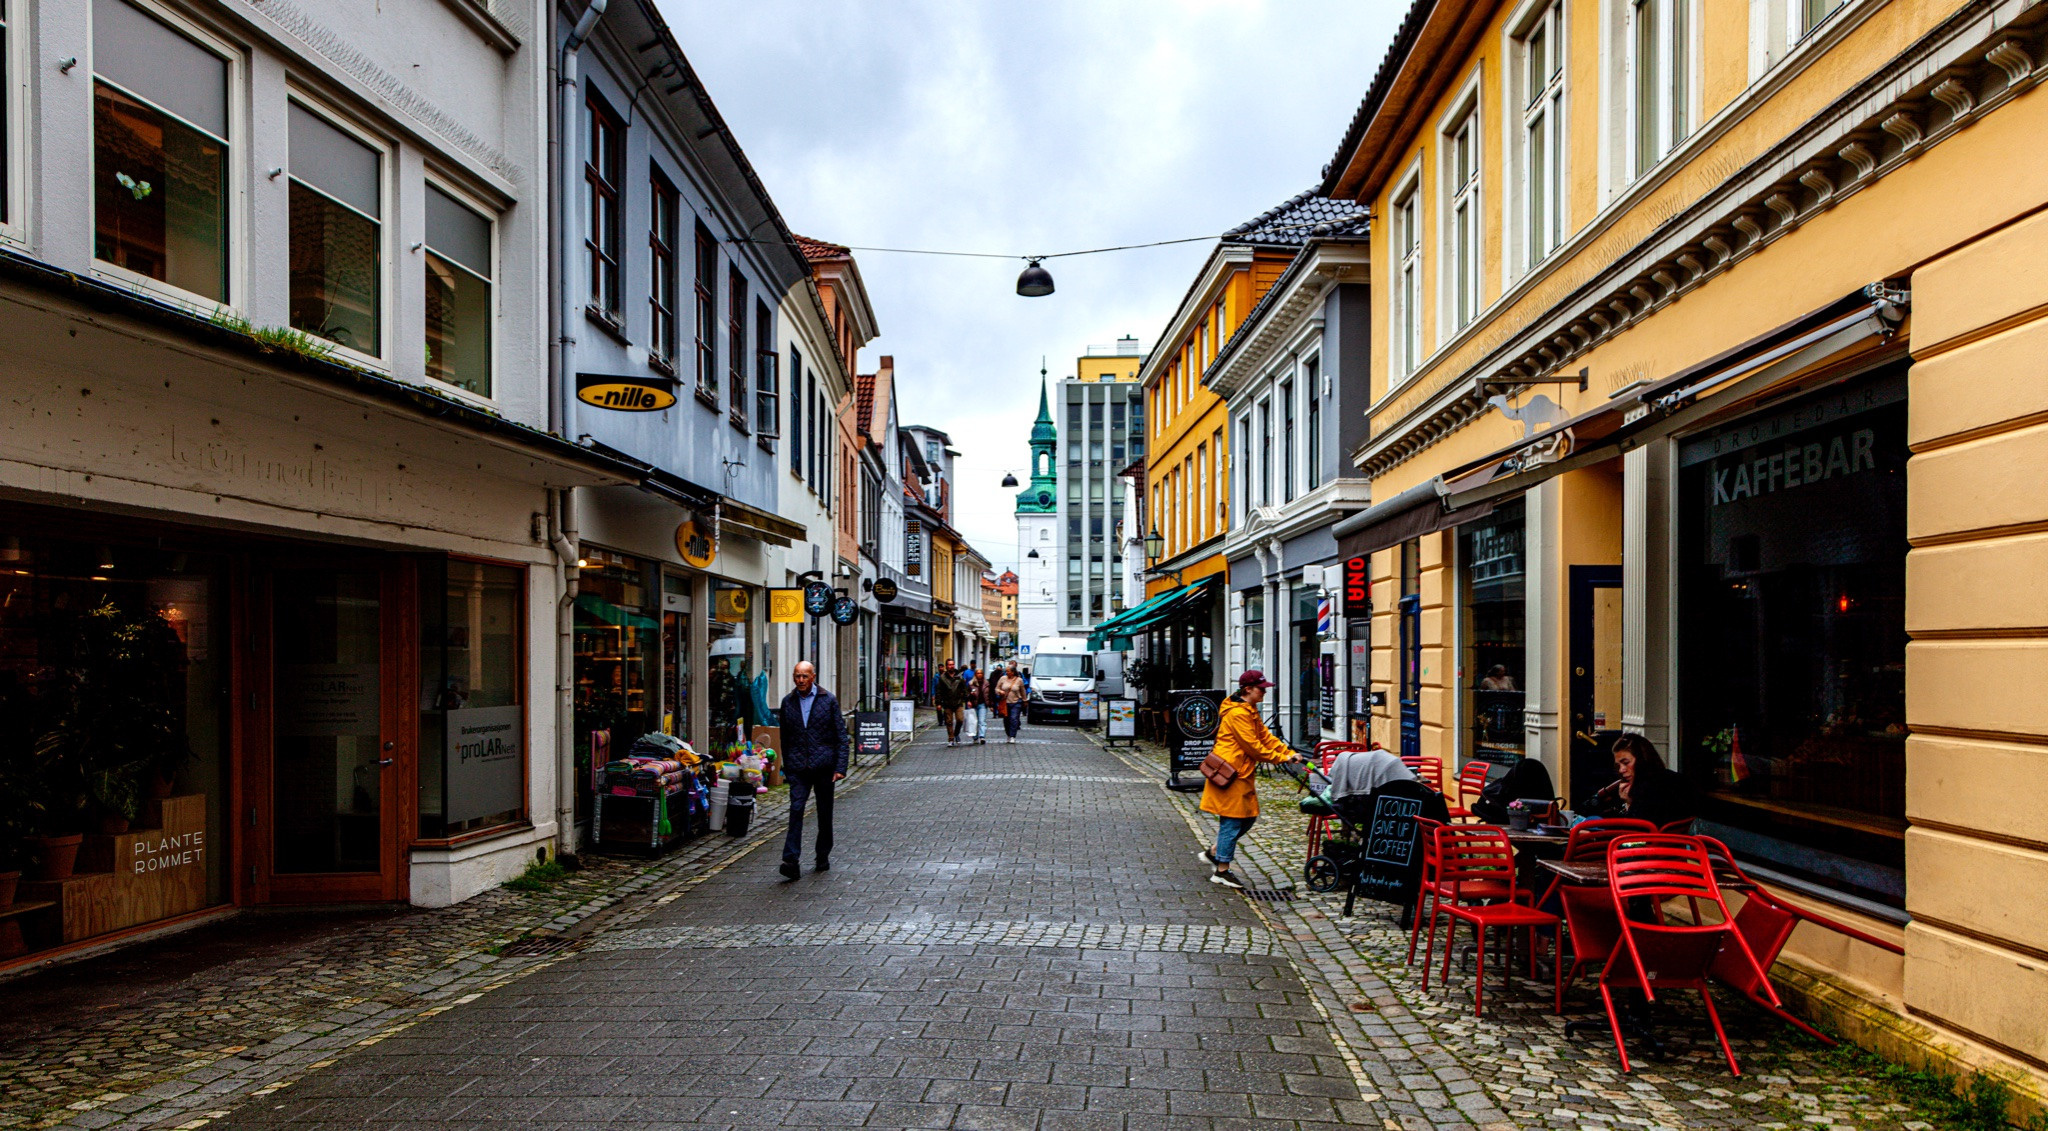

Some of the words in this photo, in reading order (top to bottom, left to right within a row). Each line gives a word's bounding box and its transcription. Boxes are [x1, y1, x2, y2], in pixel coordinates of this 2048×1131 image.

[594, 387, 656, 408] -nille
[1713, 428, 1875, 506] KAFFEBAR
[1378, 800, 1383, 815] I
[1384, 800, 1416, 817] COULD
[1374, 820, 1396, 836] GIVE
[1397, 822, 1409, 837] UP
[135, 831, 203, 856] PLANTE
[135, 848, 203, 875] ROMMET
